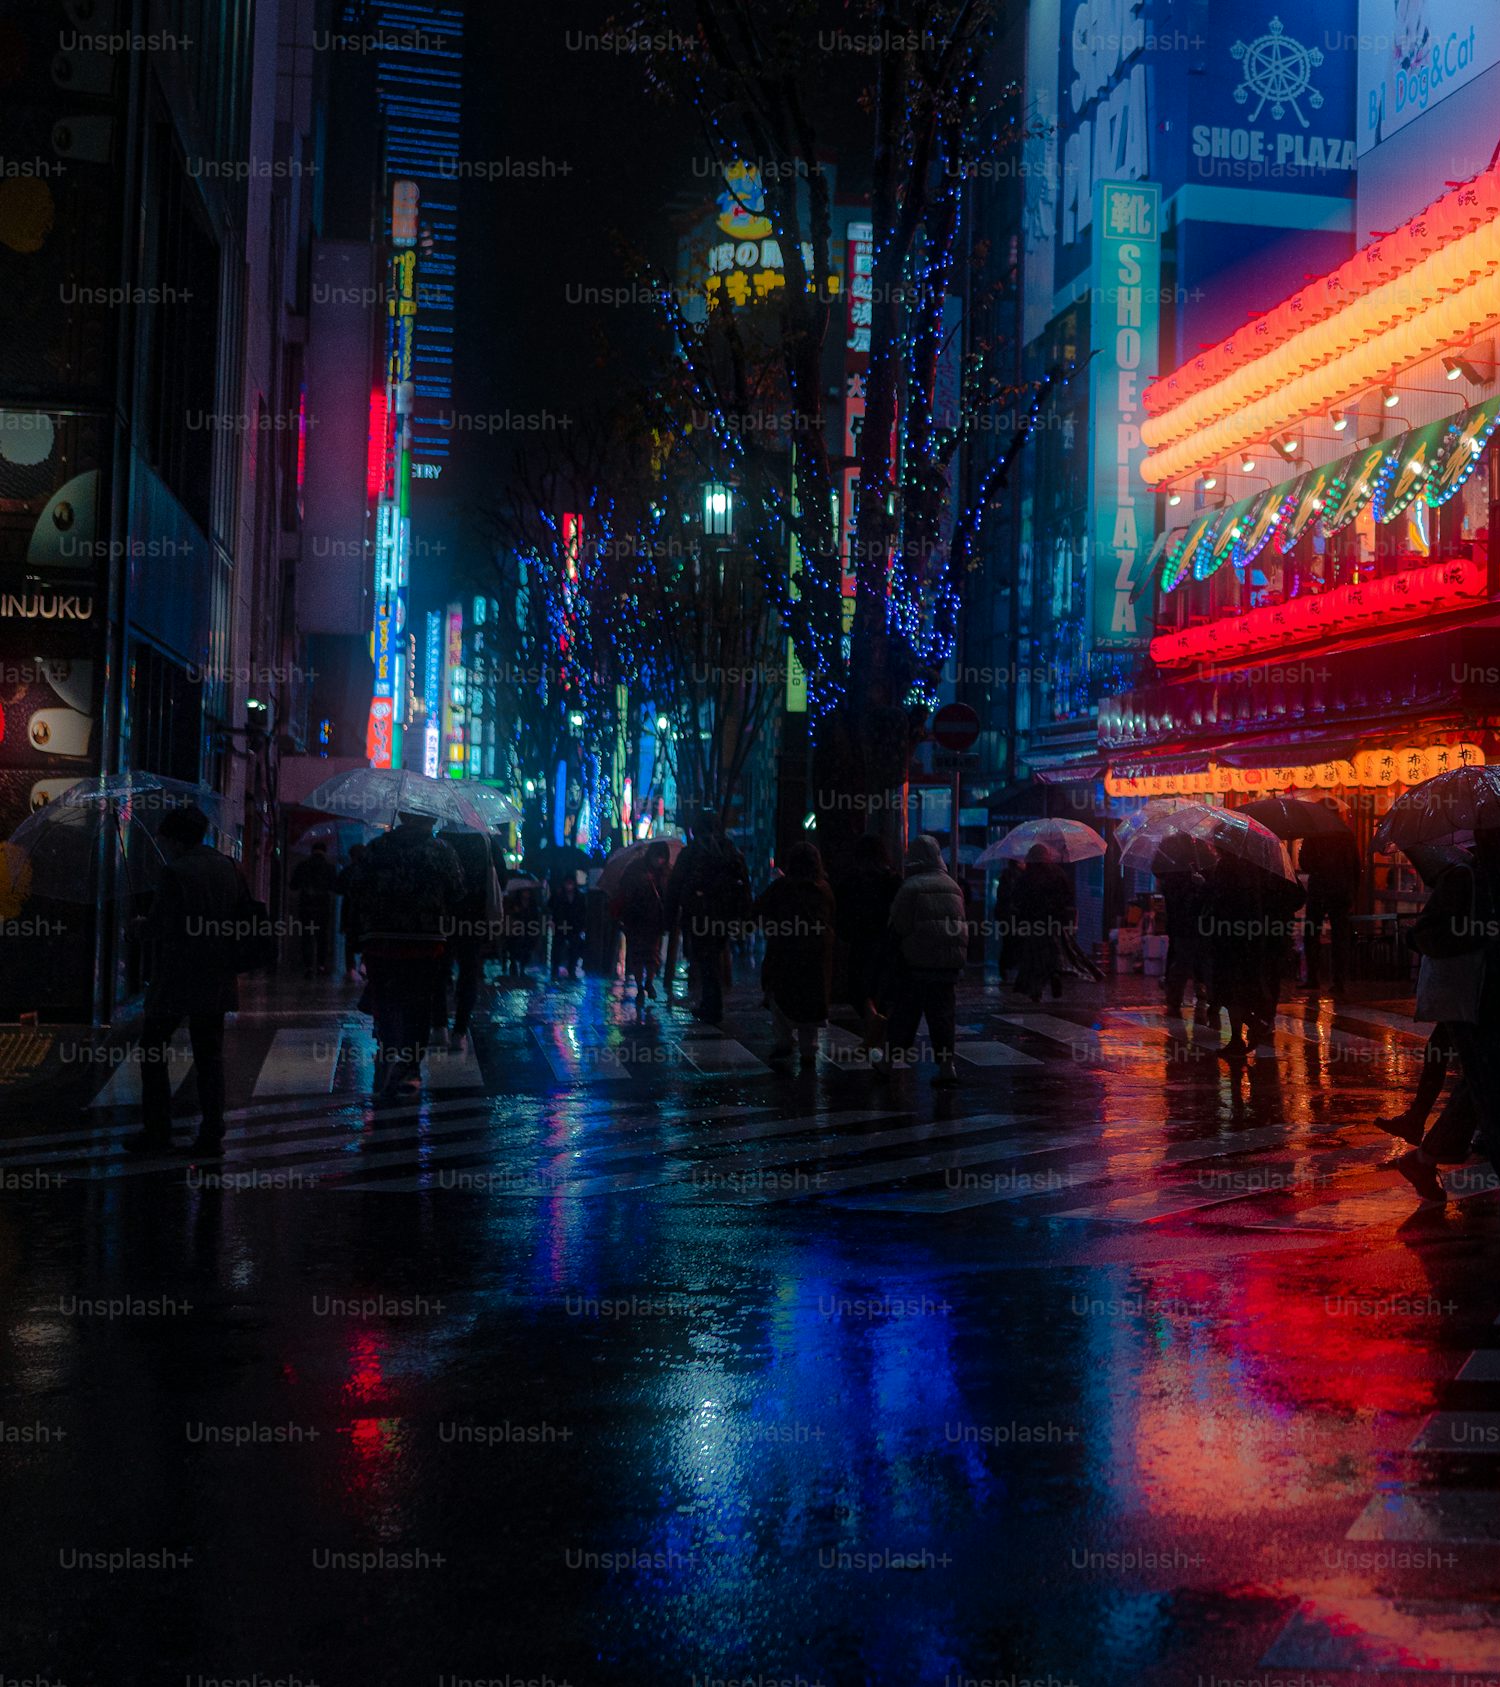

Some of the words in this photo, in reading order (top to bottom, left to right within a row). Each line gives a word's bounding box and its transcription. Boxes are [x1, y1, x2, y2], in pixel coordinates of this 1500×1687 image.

[1394, 25, 1475, 112] Dog&Cat
[1111, 191, 1151, 235] 靴
[1, 594, 93, 620] INJUKU
